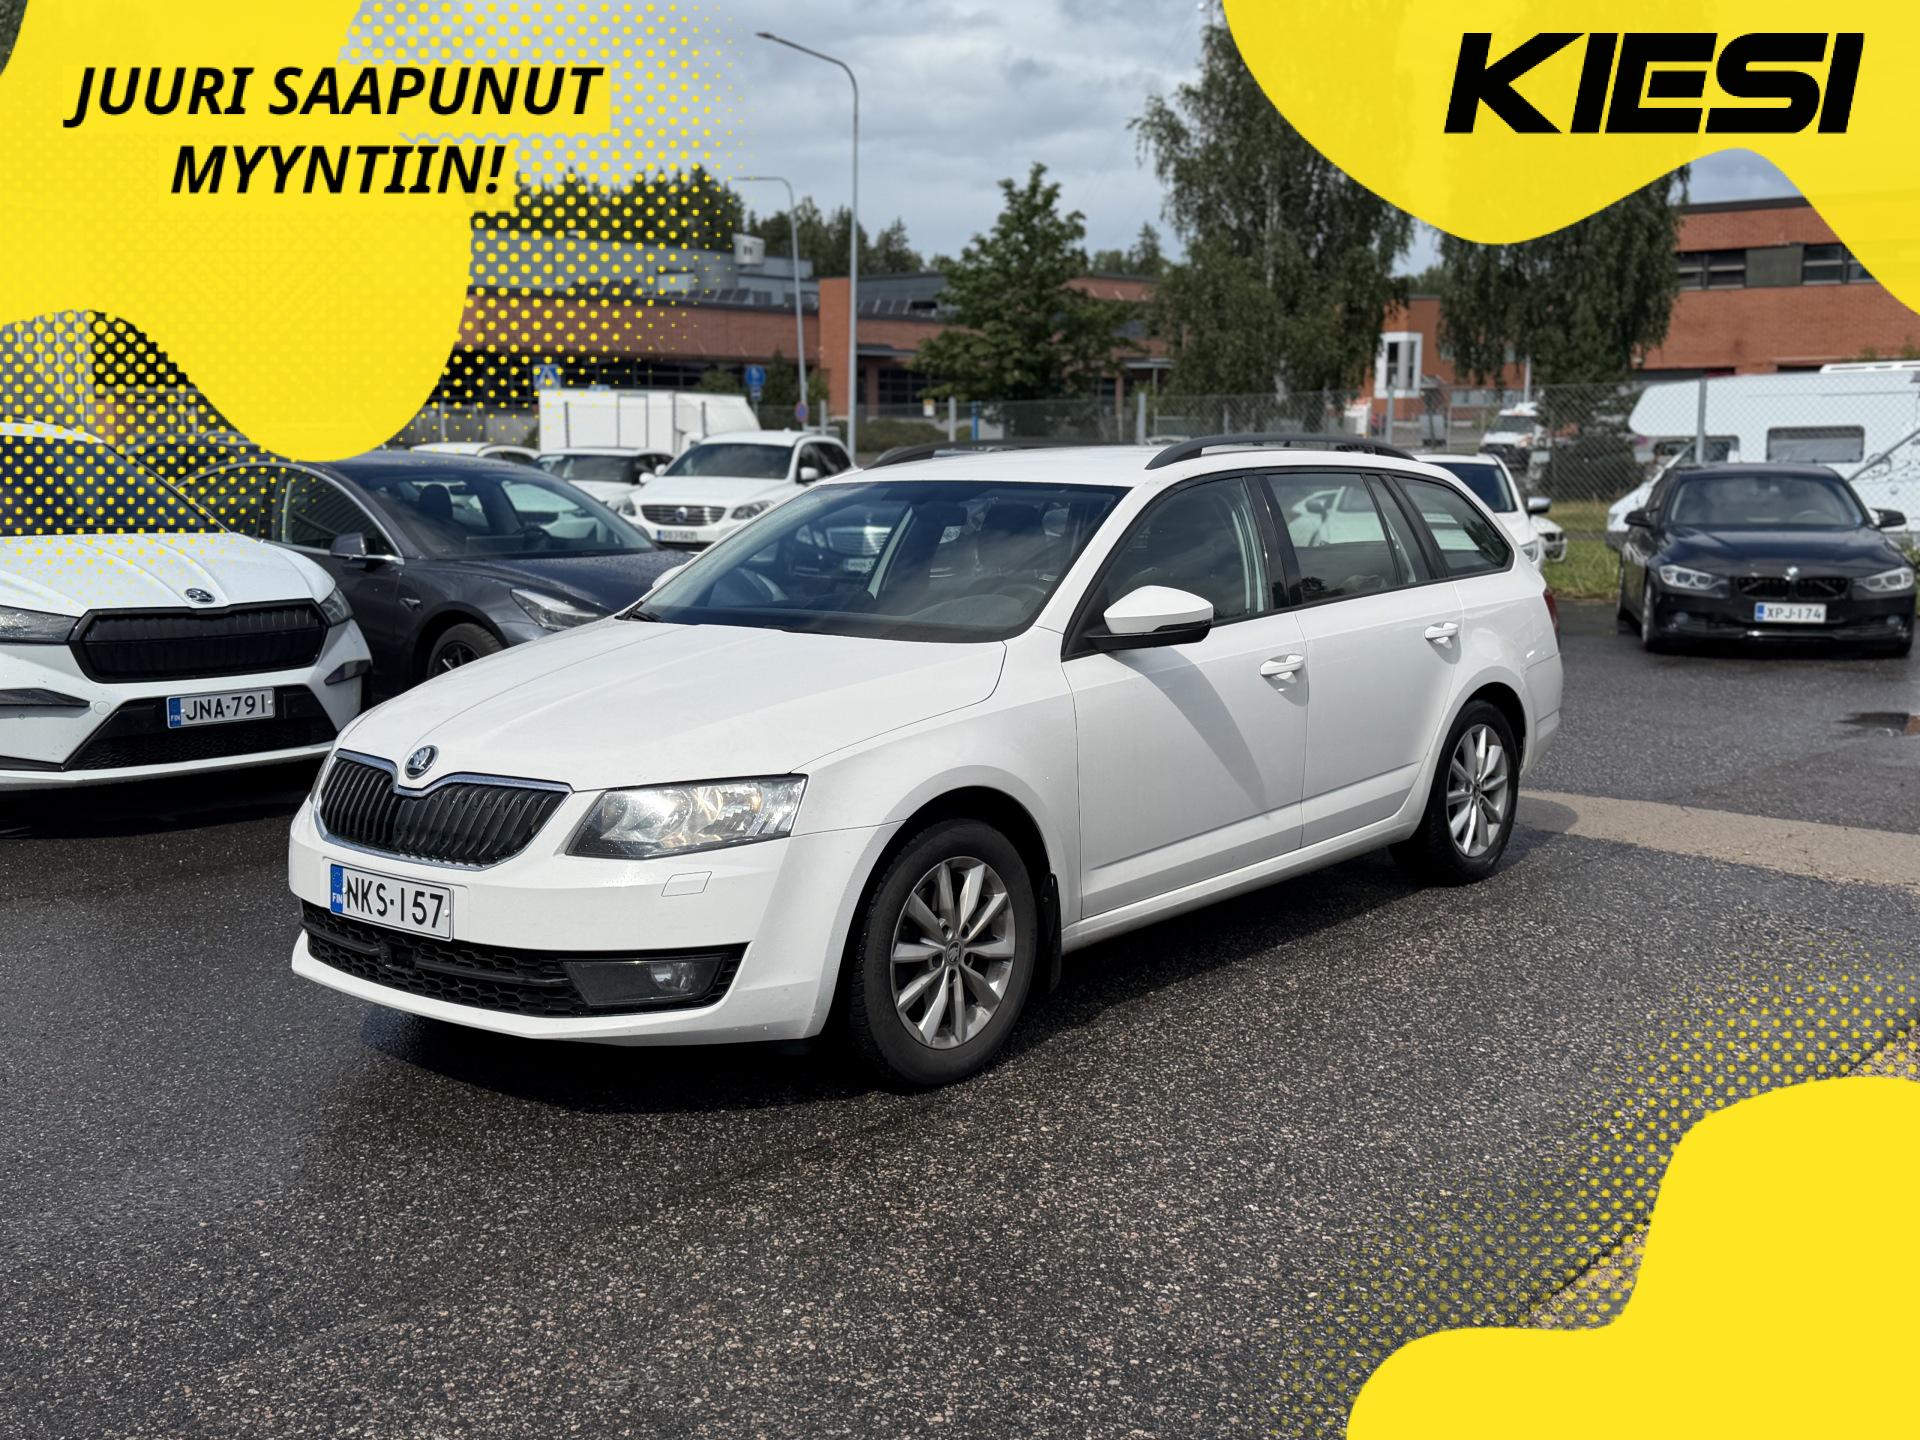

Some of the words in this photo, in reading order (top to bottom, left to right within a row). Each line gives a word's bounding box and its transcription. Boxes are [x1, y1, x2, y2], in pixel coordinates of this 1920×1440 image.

[1766, 606, 1822, 620] XPJ-174
[185, 693, 266, 721] JNA-791
[332, 892, 344, 905] FIN
[346, 874, 444, 929] NKS-157
